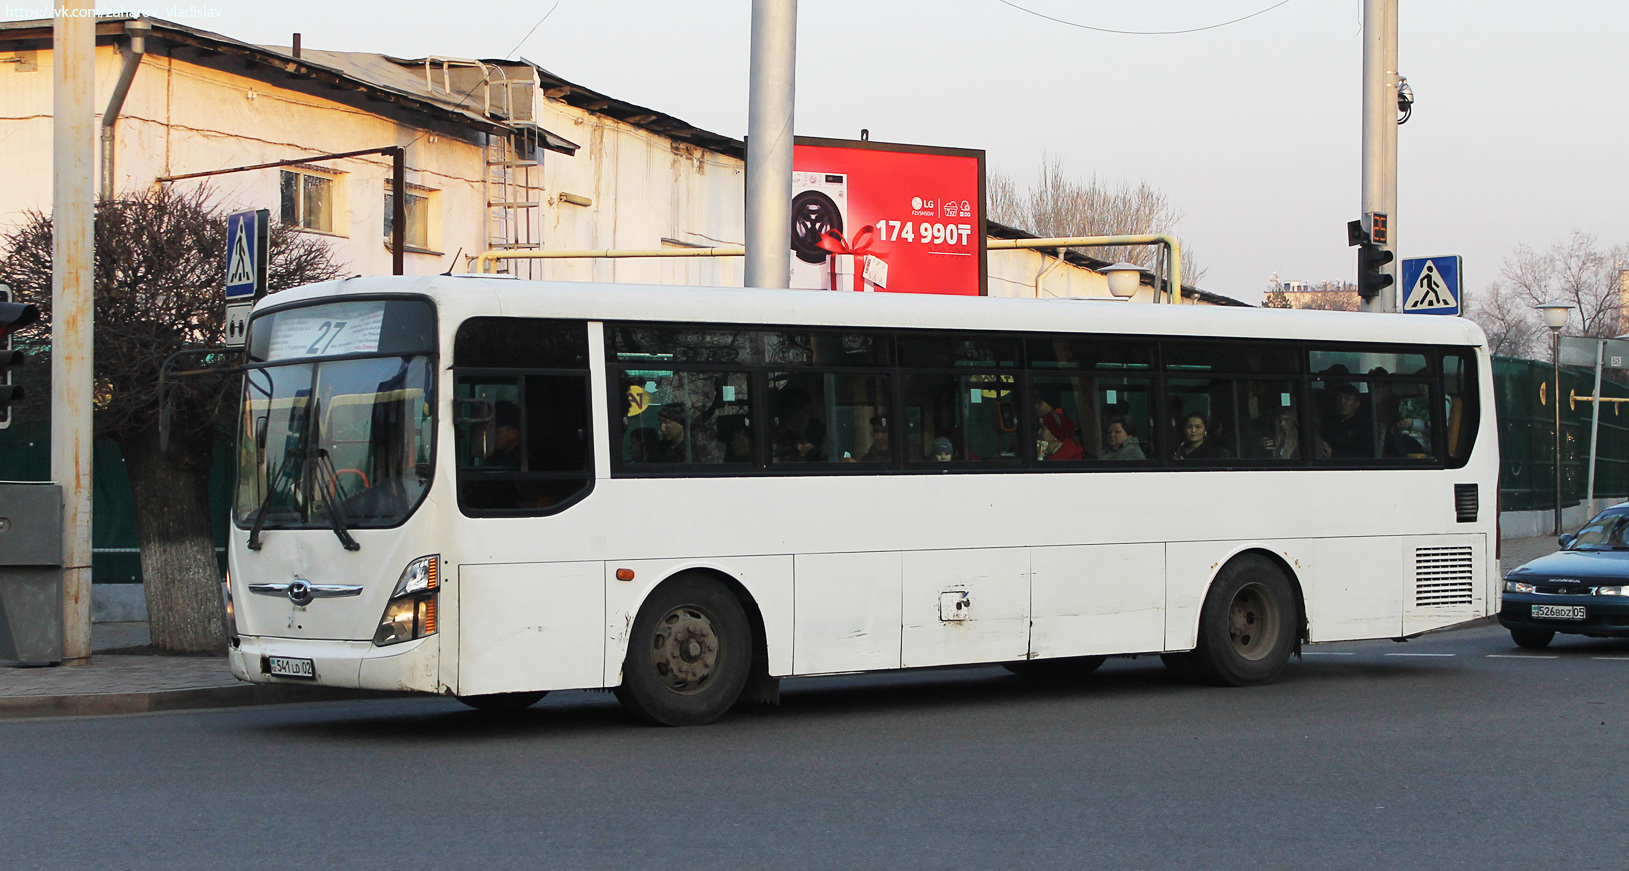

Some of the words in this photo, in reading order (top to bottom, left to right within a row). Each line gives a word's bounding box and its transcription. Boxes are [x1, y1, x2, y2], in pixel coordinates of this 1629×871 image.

[923, 200, 934, 208] LG
[876, 220, 914, 242] 174
[305, 320, 348, 355] 27
[276, 660, 290, 672] 541
[302, 662, 312, 675] 02
